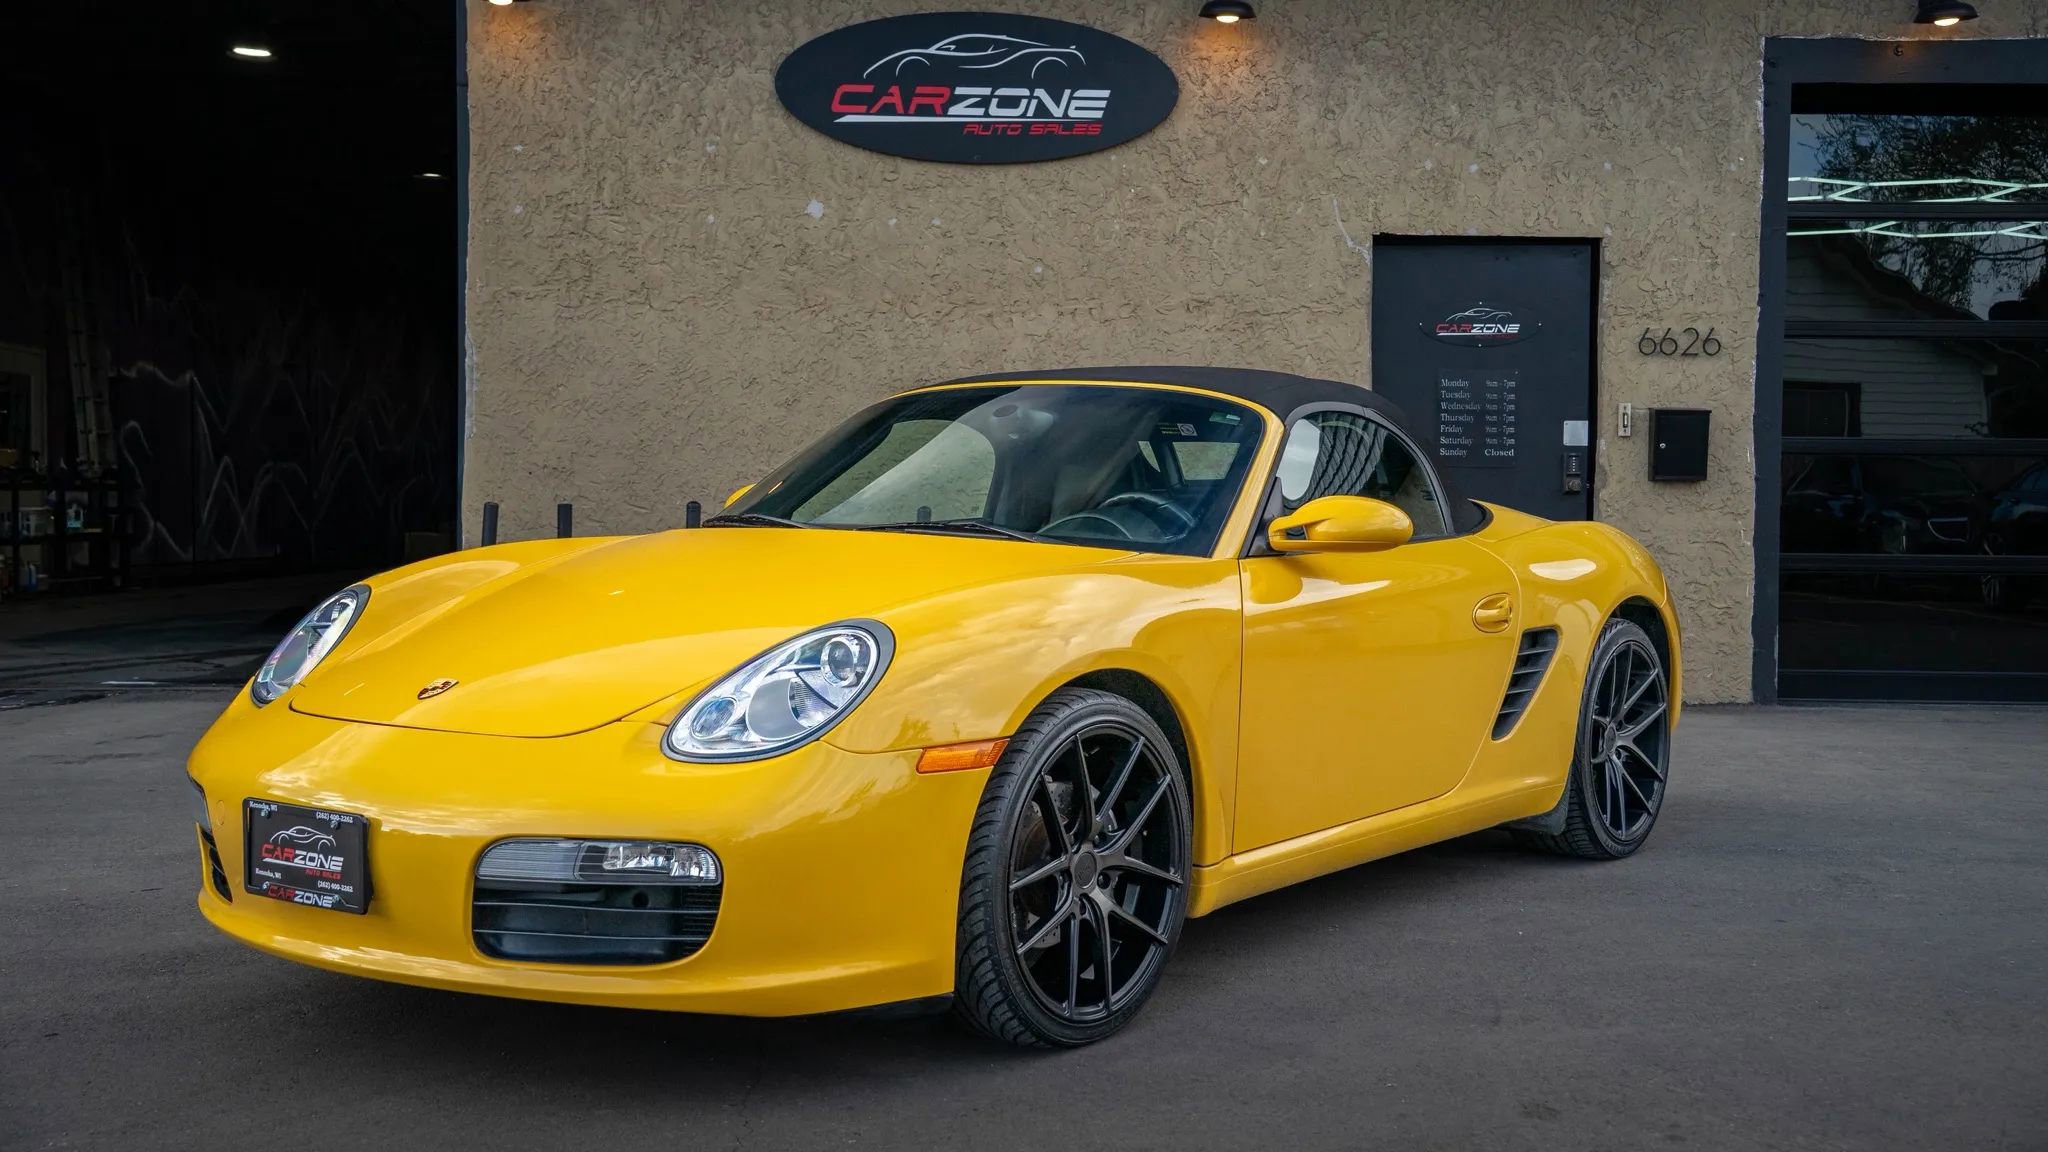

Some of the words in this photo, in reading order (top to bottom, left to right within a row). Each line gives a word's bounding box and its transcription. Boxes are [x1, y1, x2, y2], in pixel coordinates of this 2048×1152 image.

[831, 84, 1111, 118] CARZONE
[963, 123, 1021, 135] AUTO
[1029, 124, 1103, 135] SALES
[1436, 323, 1520, 333] CARZONE
[1639, 327, 1721, 356] 6626
[1441, 379, 1469, 389] Monday
[1441, 390, 1471, 400] Tuesday
[1440, 402, 1480, 412] Wednesday
[1440, 413, 1474, 423] Thursday
[1440, 425, 1463, 434] Friday
[1440, 436, 1472, 446] Saturday
[1440, 448, 1467, 457] Sunday
[262, 844, 344, 871] CARZONE
[268, 885, 334, 908] CARZONE
